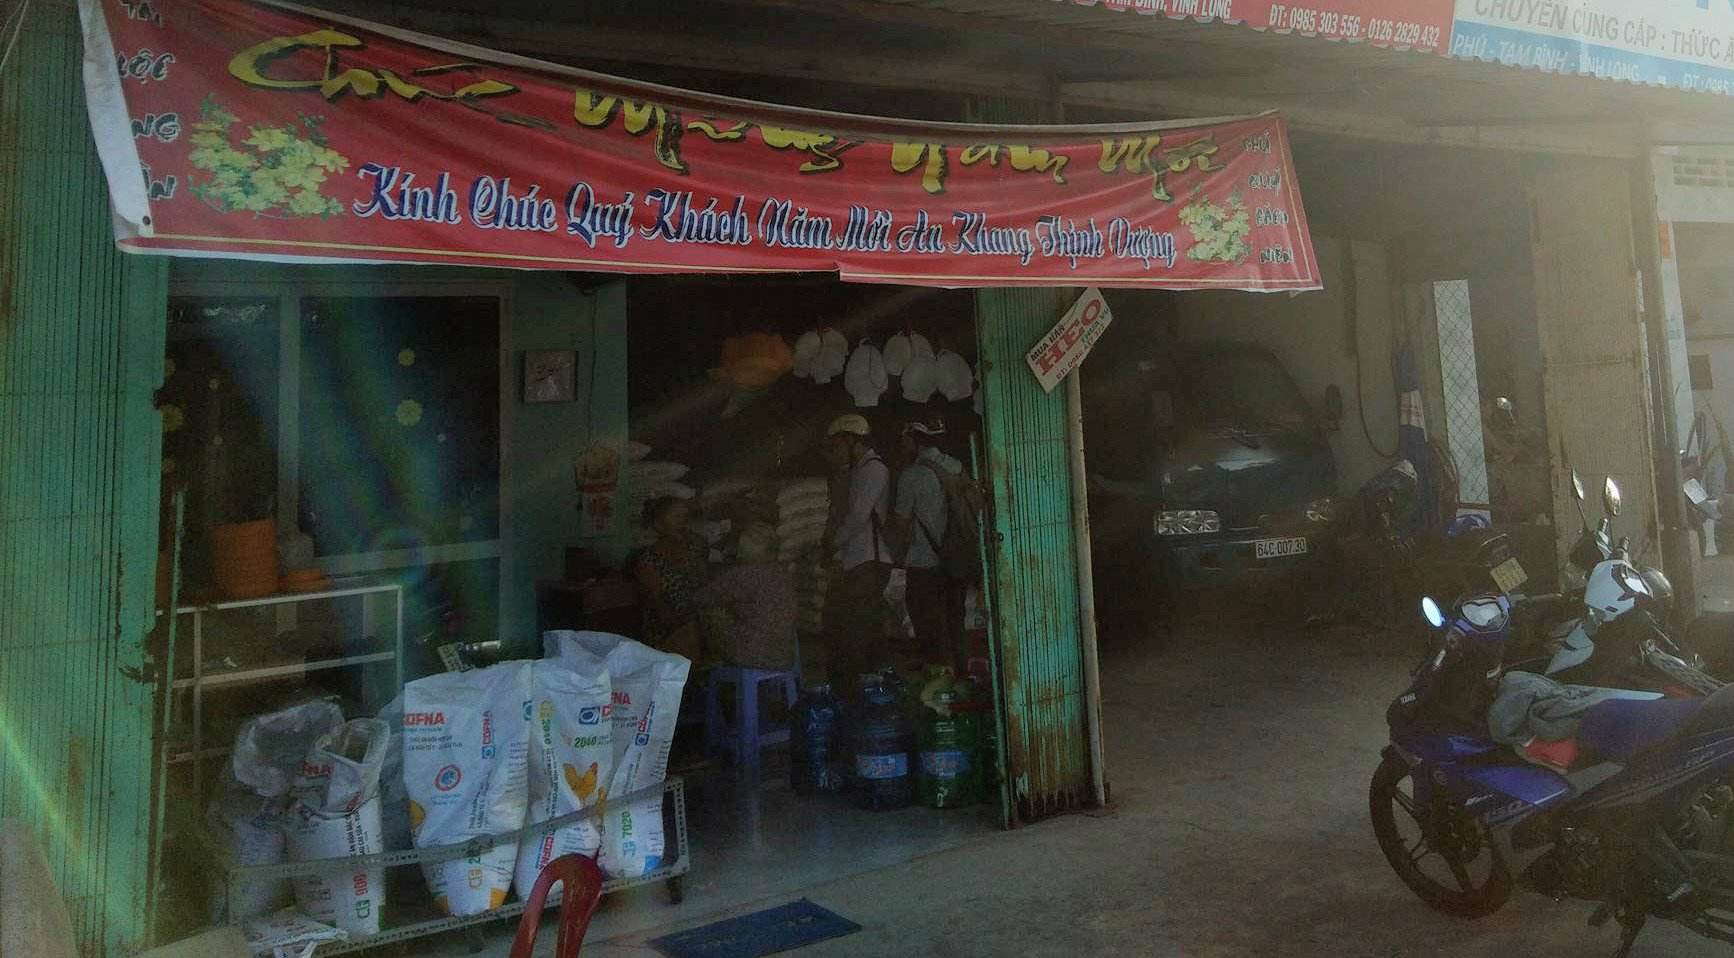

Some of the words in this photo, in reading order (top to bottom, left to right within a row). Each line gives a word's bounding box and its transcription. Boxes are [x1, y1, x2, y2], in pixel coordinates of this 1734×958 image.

[1269, 4, 1287, 27] ĐT:
[1290, 6, 1316, 32] 0985
[1318, 11, 1338, 34] 303
[1340, 14, 1361, 37] 556
[1368, 18, 1393, 41] 0126
[1394, 21, 1421, 45] 2829
[1421, 25, 1440, 48] 432
[352, 161, 461, 225] Kính
[469, 175, 559, 233] Chúc
[566, 180, 635, 249] Quý
[640, 187, 752, 246] Khách
[756, 196, 834, 250] Năm
[834, 203, 894, 253] Mới
[896, 208, 945, 254] An
[947, 208, 1035, 267] Khang
[1035, 215, 1105, 270] Thịnh
[1035, 298, 1101, 376] HEO
[620, 811, 632, 838] 7020
